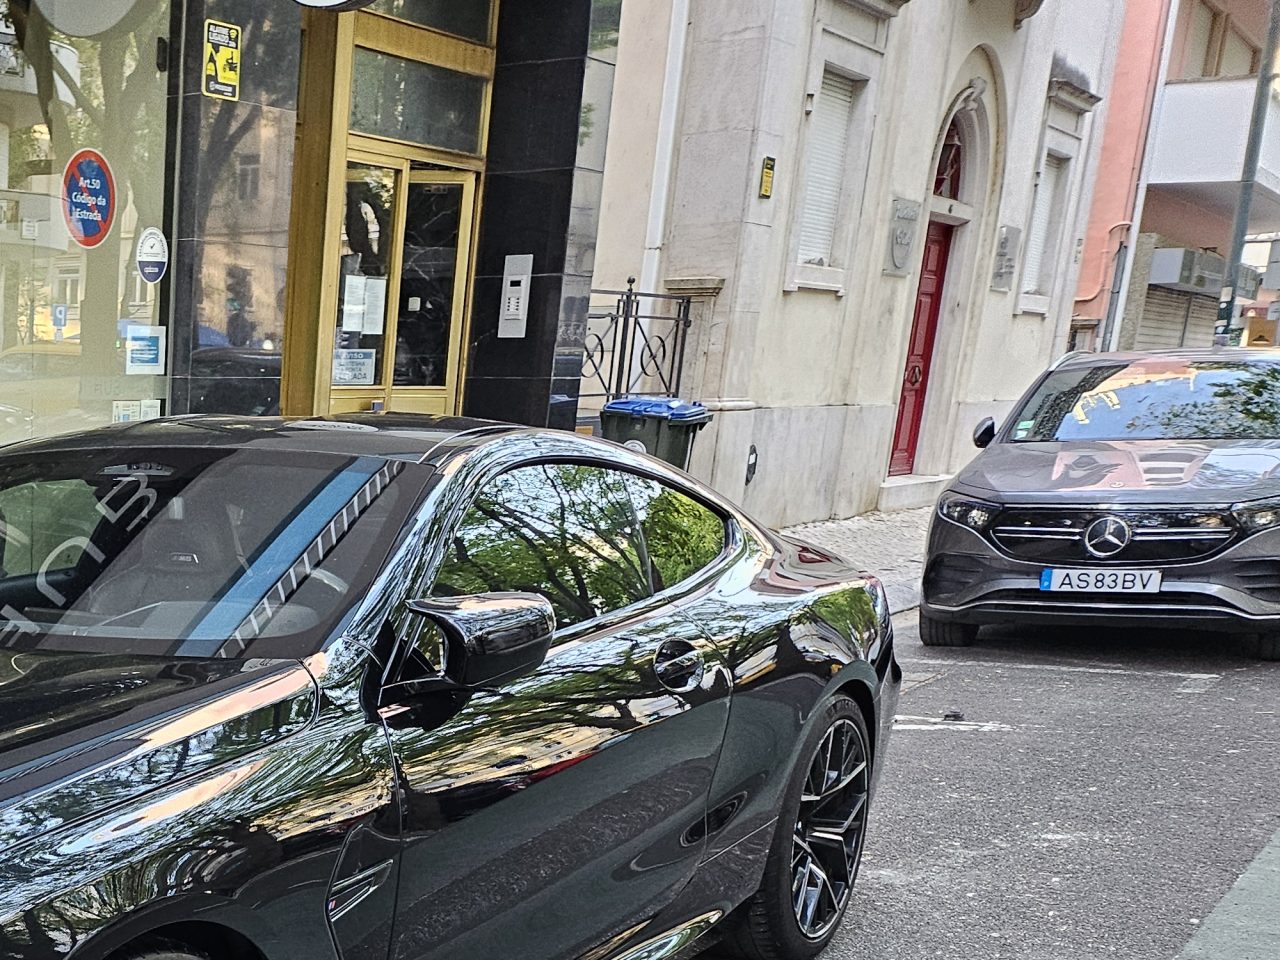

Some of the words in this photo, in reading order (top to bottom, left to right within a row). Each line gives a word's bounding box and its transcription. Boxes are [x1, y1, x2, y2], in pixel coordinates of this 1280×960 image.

[72, 192, 97, 206] Código
[97, 194, 107, 206] da
[76, 207, 102, 220] Estrada
[1058, 572, 1153, 590] AS83BV
